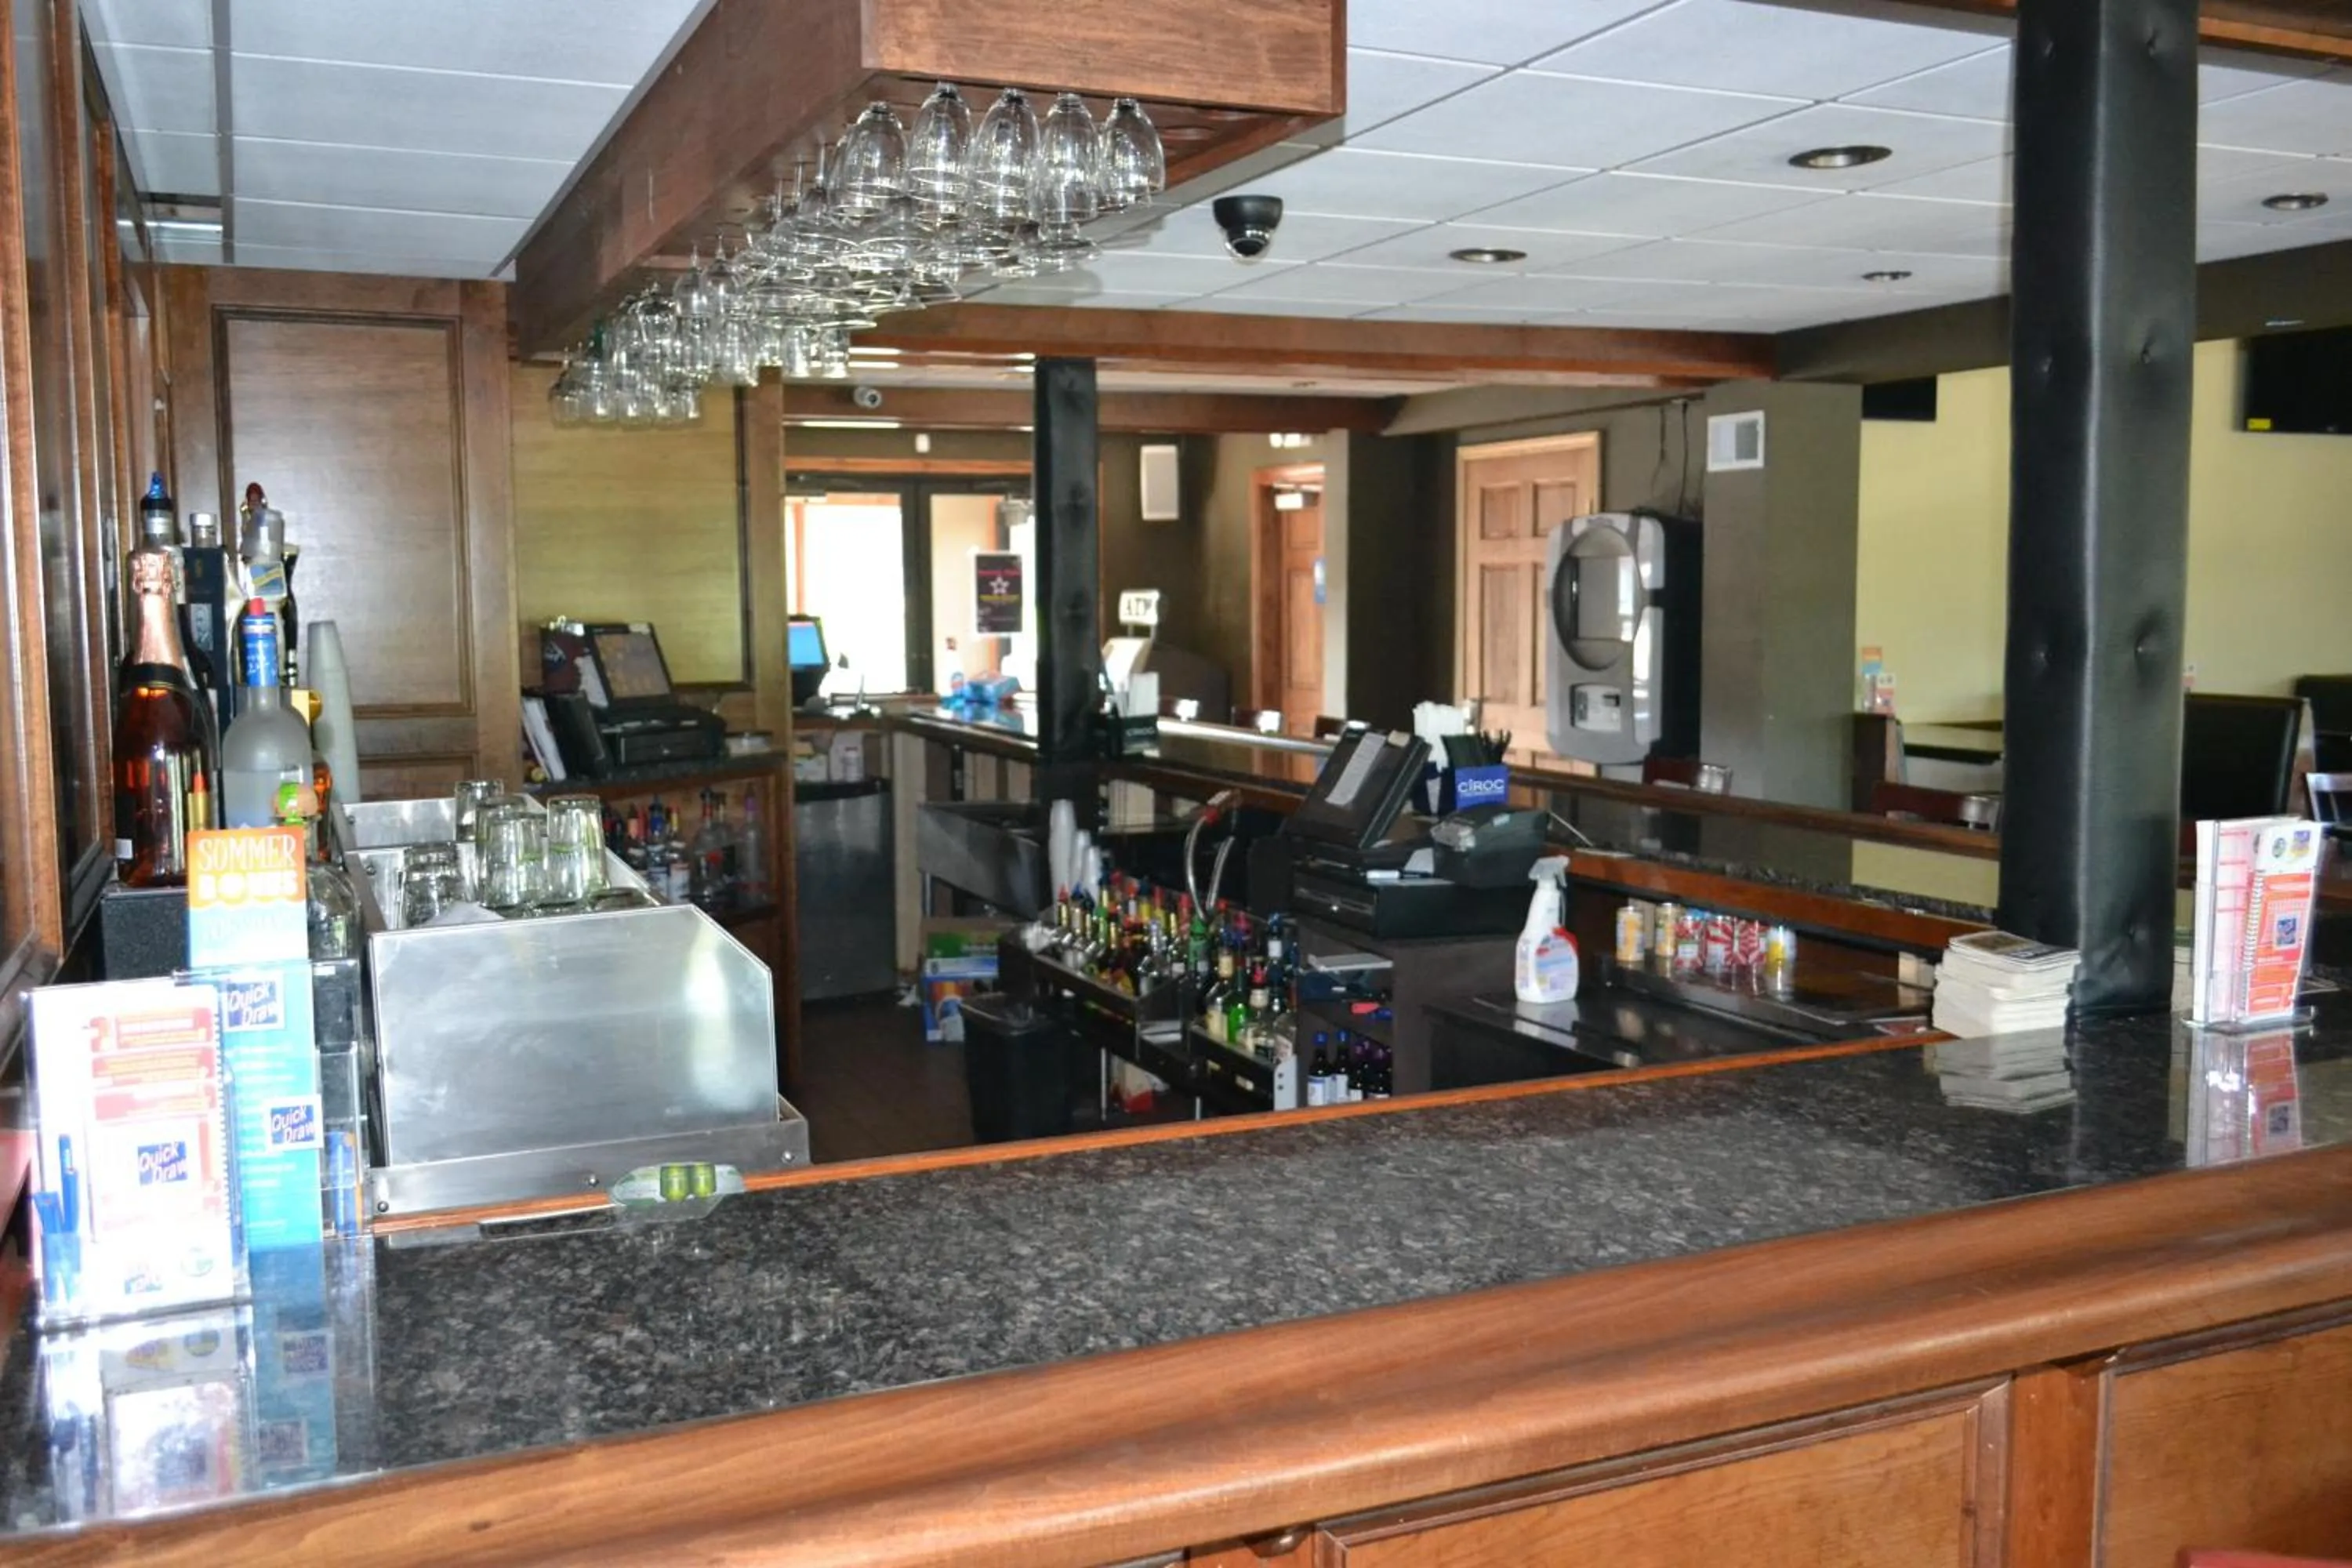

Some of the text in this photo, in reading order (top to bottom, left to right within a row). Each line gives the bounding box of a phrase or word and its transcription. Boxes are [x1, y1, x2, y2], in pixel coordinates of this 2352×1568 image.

[229, 982, 272, 1011] Quick
[241, 1002, 278, 1025] Draw
[271, 1105, 308, 1133] Quick
[283, 1120, 315, 1145] Draw
[139, 1141, 180, 1172] Quick
[152, 1160, 187, 1184] Draw
